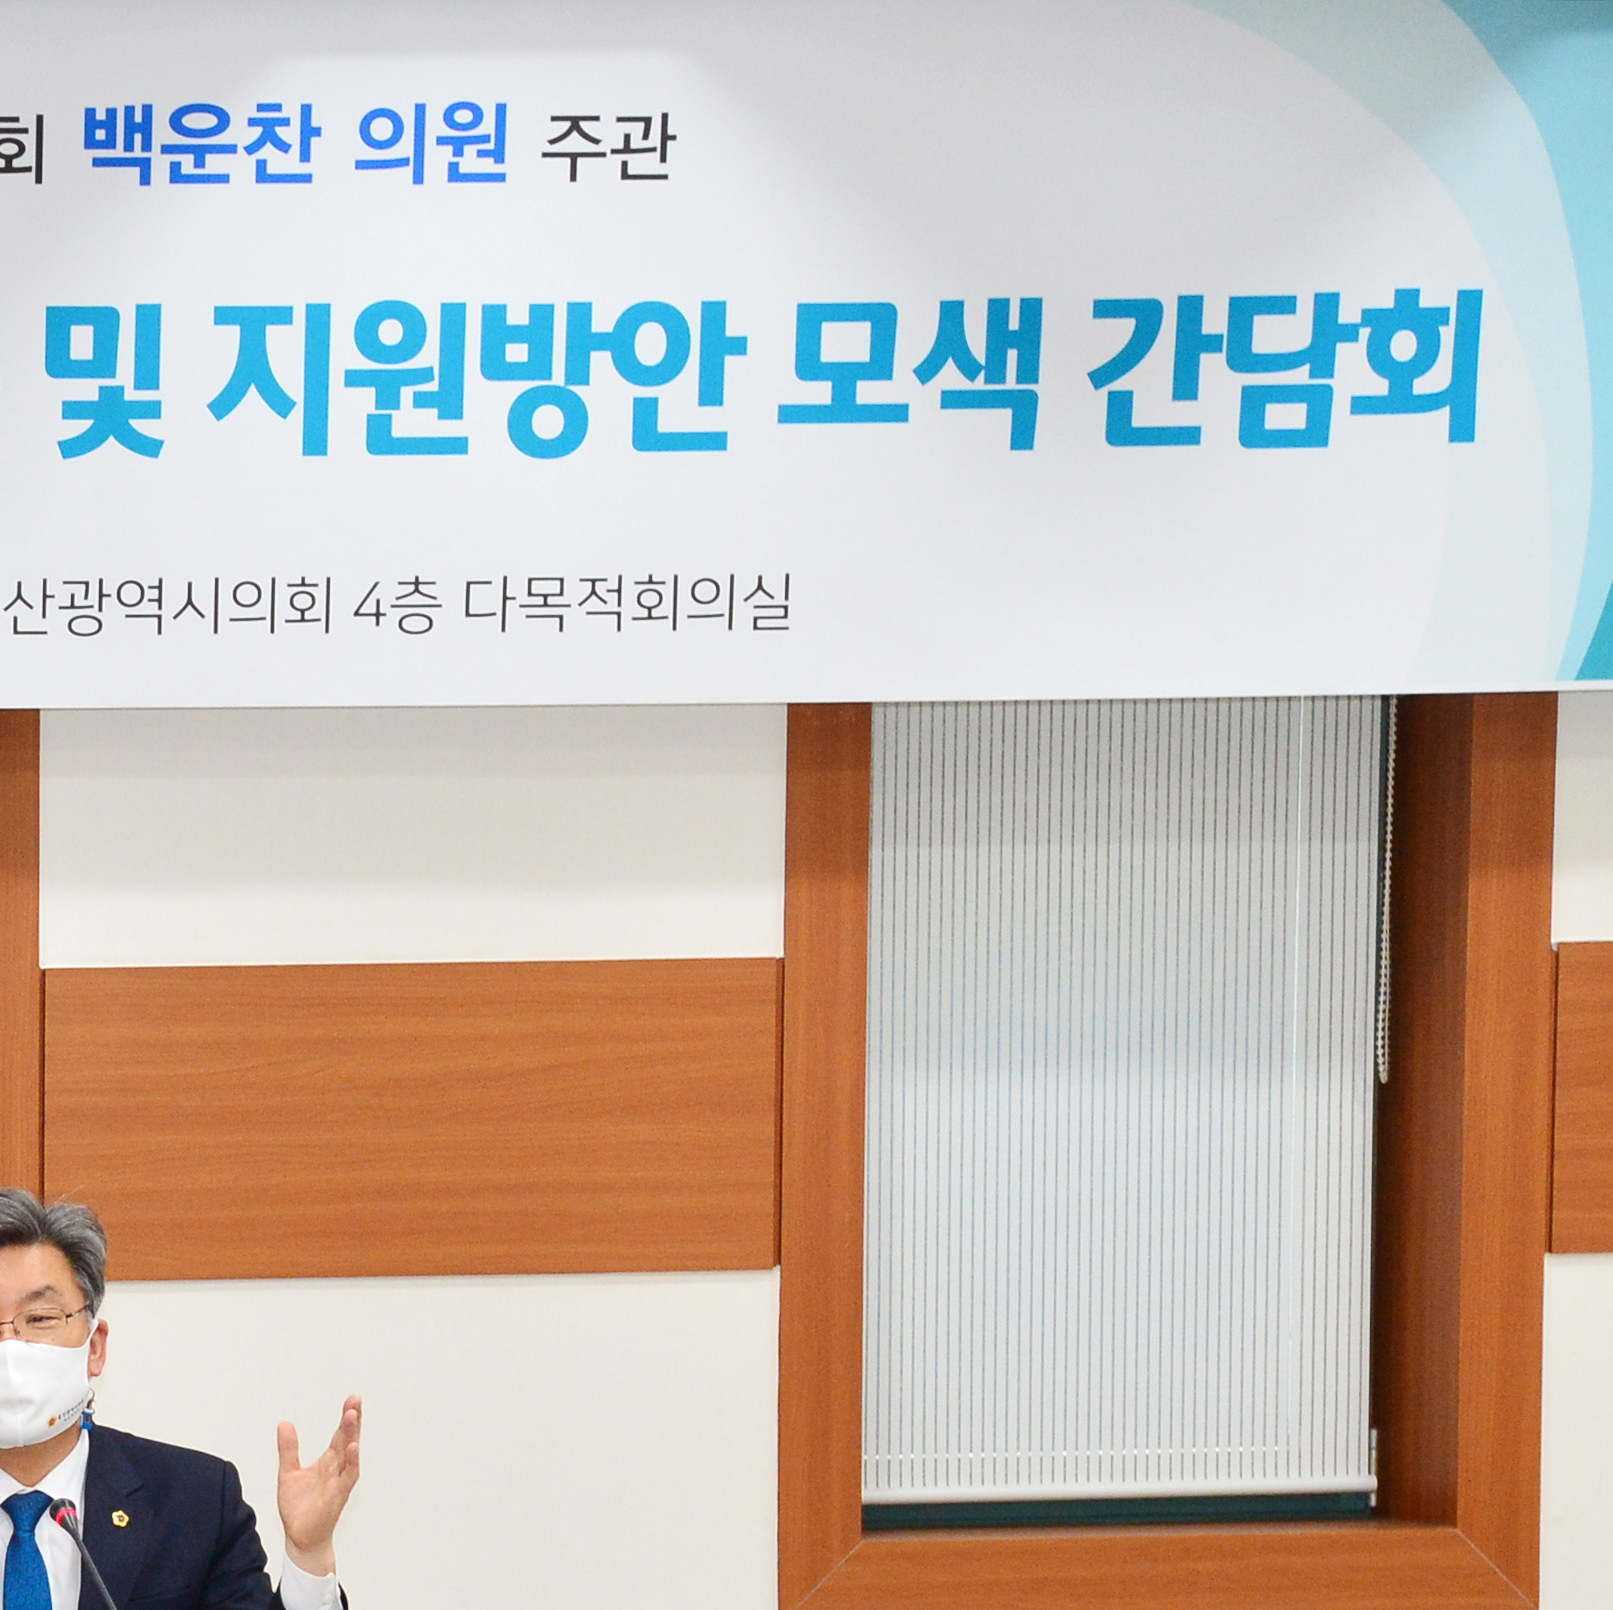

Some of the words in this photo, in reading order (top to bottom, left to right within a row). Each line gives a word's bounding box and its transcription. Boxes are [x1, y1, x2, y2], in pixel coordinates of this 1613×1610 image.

[83, 102, 325, 188] 백운찬
[353, 101, 510, 187] 의원
[540, 111, 679, 184] 주관
[43, 302, 167, 462] 및
[205, 299, 751, 462] 지원방안
[777, 296, 1046, 454] 모색
[1087, 286, 1486, 452] 간담회
[351, 574, 444, 637] 4층
[464, 572, 793, 634] 다목적회의실
